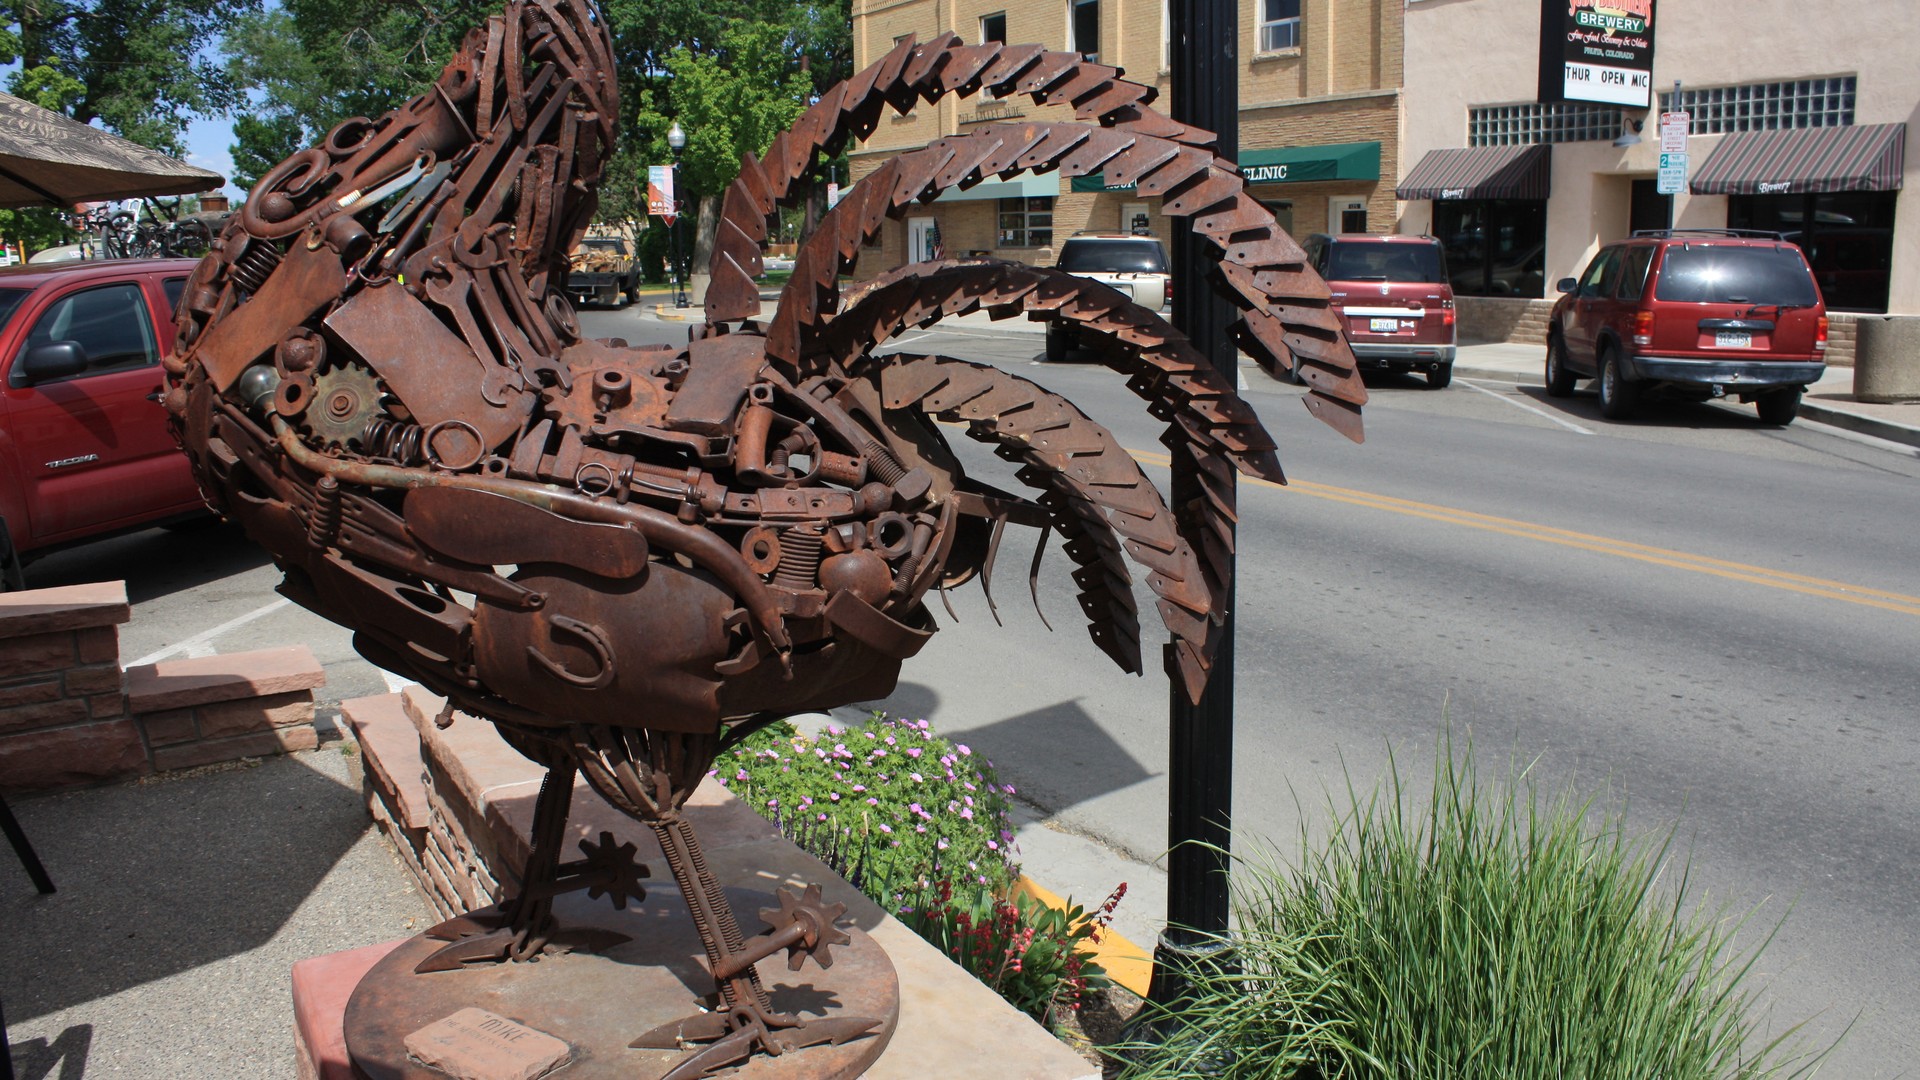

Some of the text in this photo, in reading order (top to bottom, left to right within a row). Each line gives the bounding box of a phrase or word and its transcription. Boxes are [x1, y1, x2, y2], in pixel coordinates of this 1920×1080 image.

[1580, 12, 1641, 31] BREWERY
[1605, 49, 1635, 60] COLORADO
[1565, 66, 1648, 88] THUR OPEN MIC
[1660, 156, 1668, 167] 2
[1243, 164, 1288, 181] CLINIC
[1441, 188, 1465, 199] Brewery
[1758, 181, 1791, 194] Brewery
[45, 453, 99, 469] TACOMA
